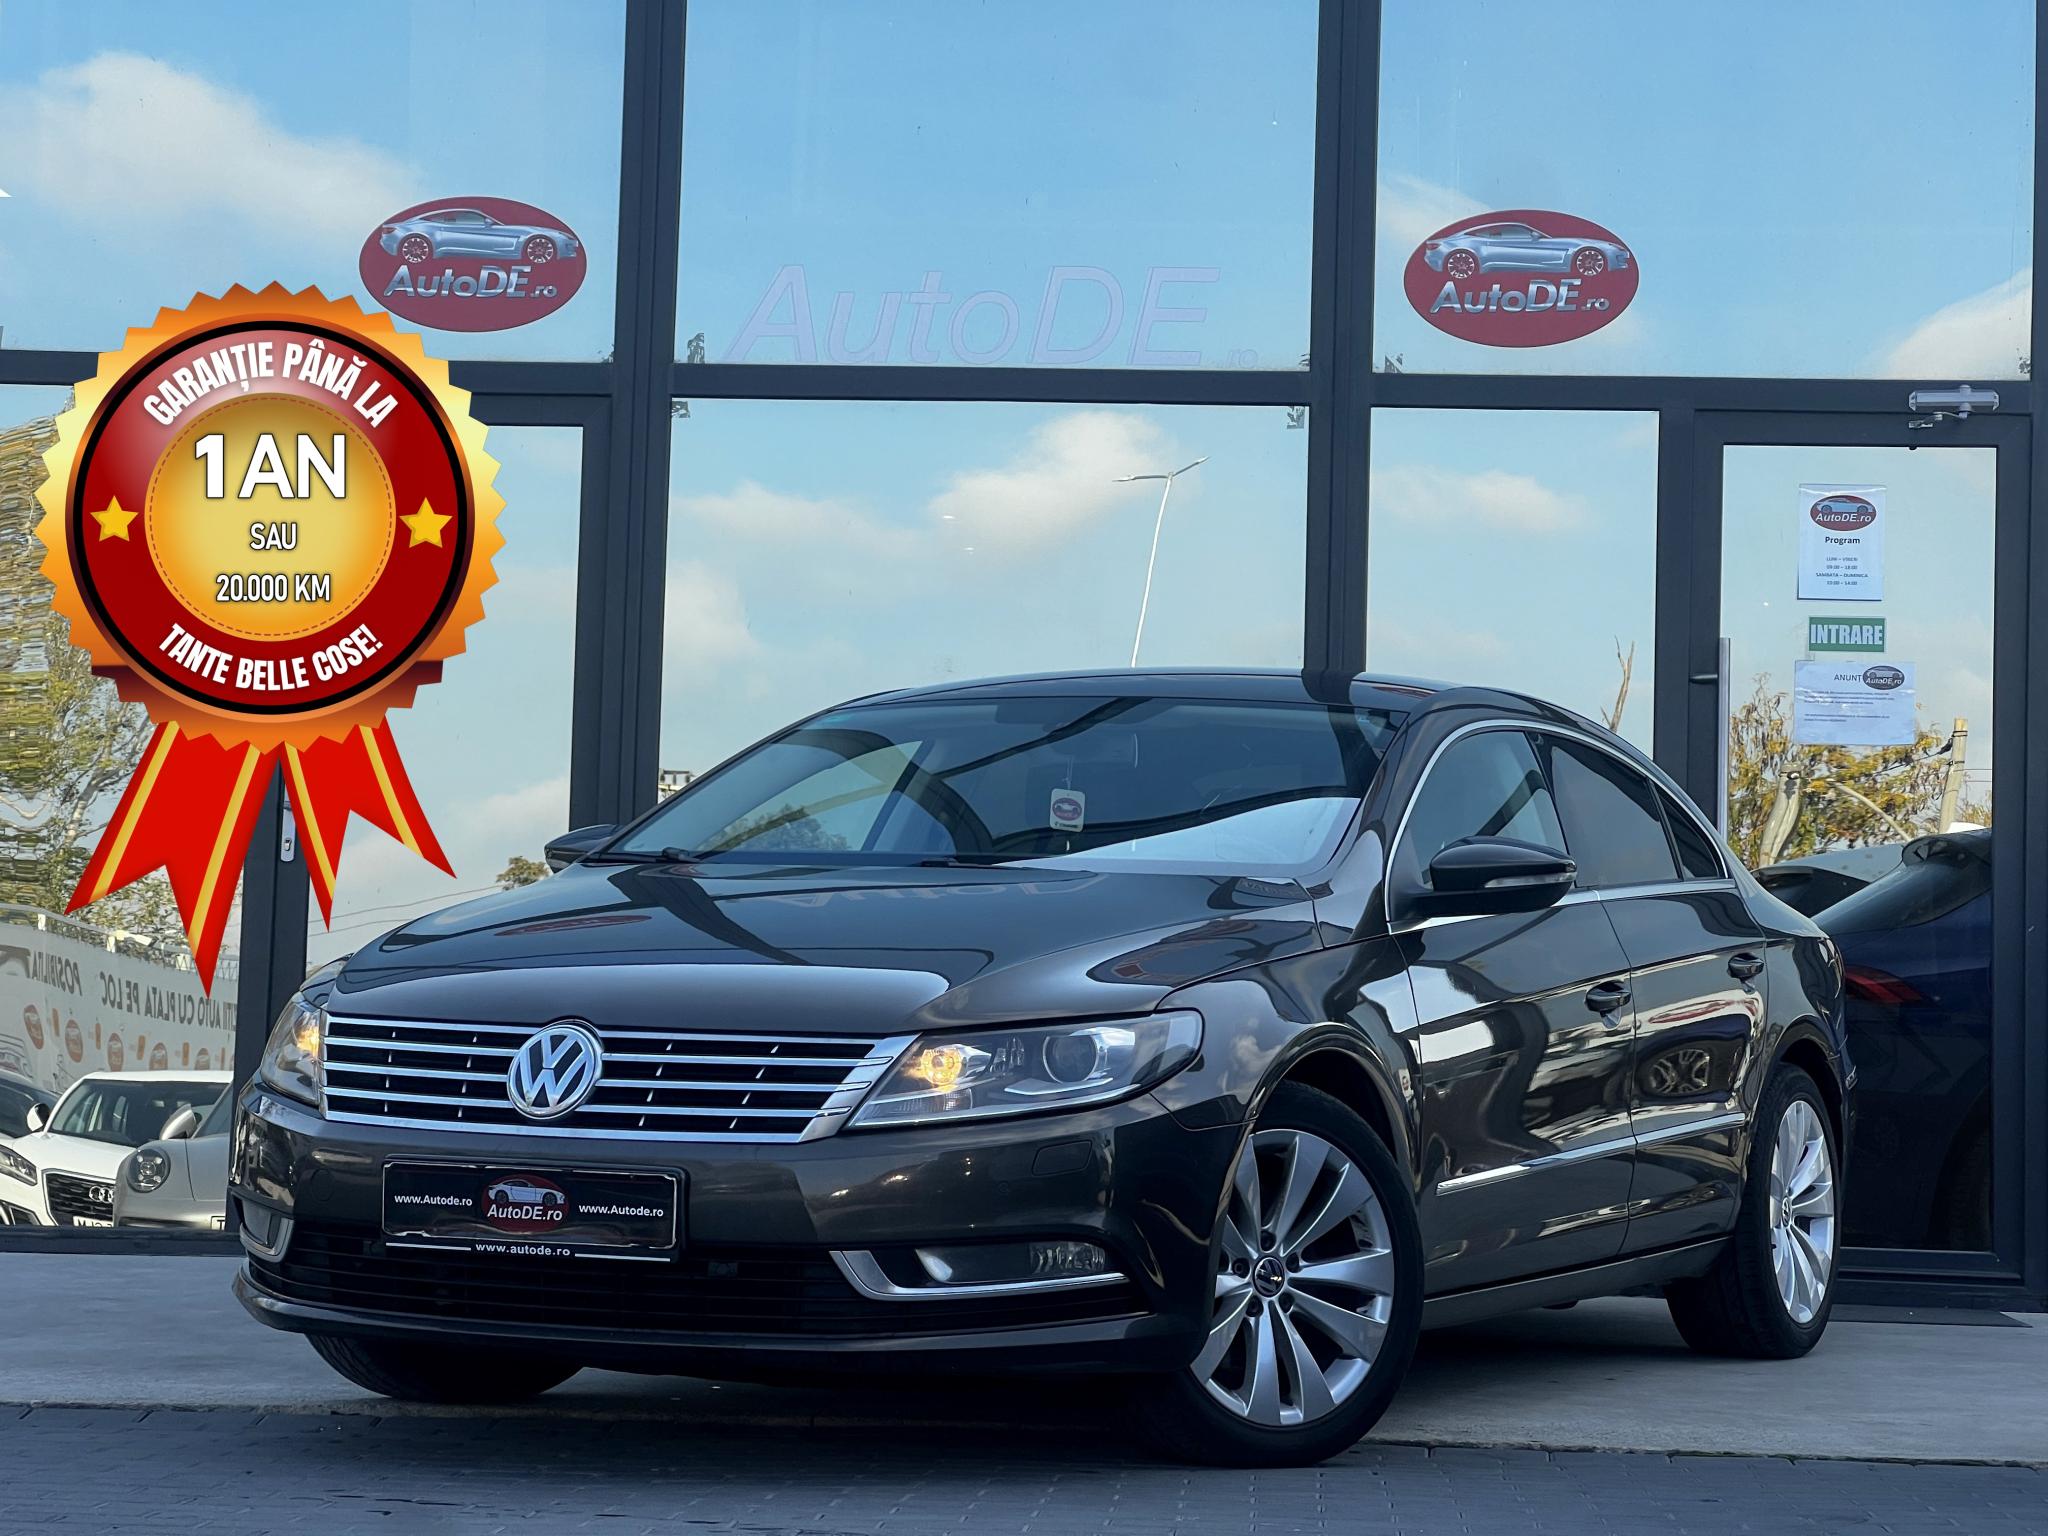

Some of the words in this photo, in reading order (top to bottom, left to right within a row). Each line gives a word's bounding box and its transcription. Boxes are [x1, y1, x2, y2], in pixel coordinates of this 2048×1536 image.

[1815, 513, 1872, 522] AutoDE.ro
[1824, 536, 1861, 546] Program
[1810, 624, 1884, 646] INTRARE
[394, 1193, 473, 1207] www.Autode.ro
[487, 1203, 563, 1221] AutoDE.ro
[578, 1203, 664, 1217] www.Autode.ro
[475, 1242, 571, 1257] www.autode.ro
